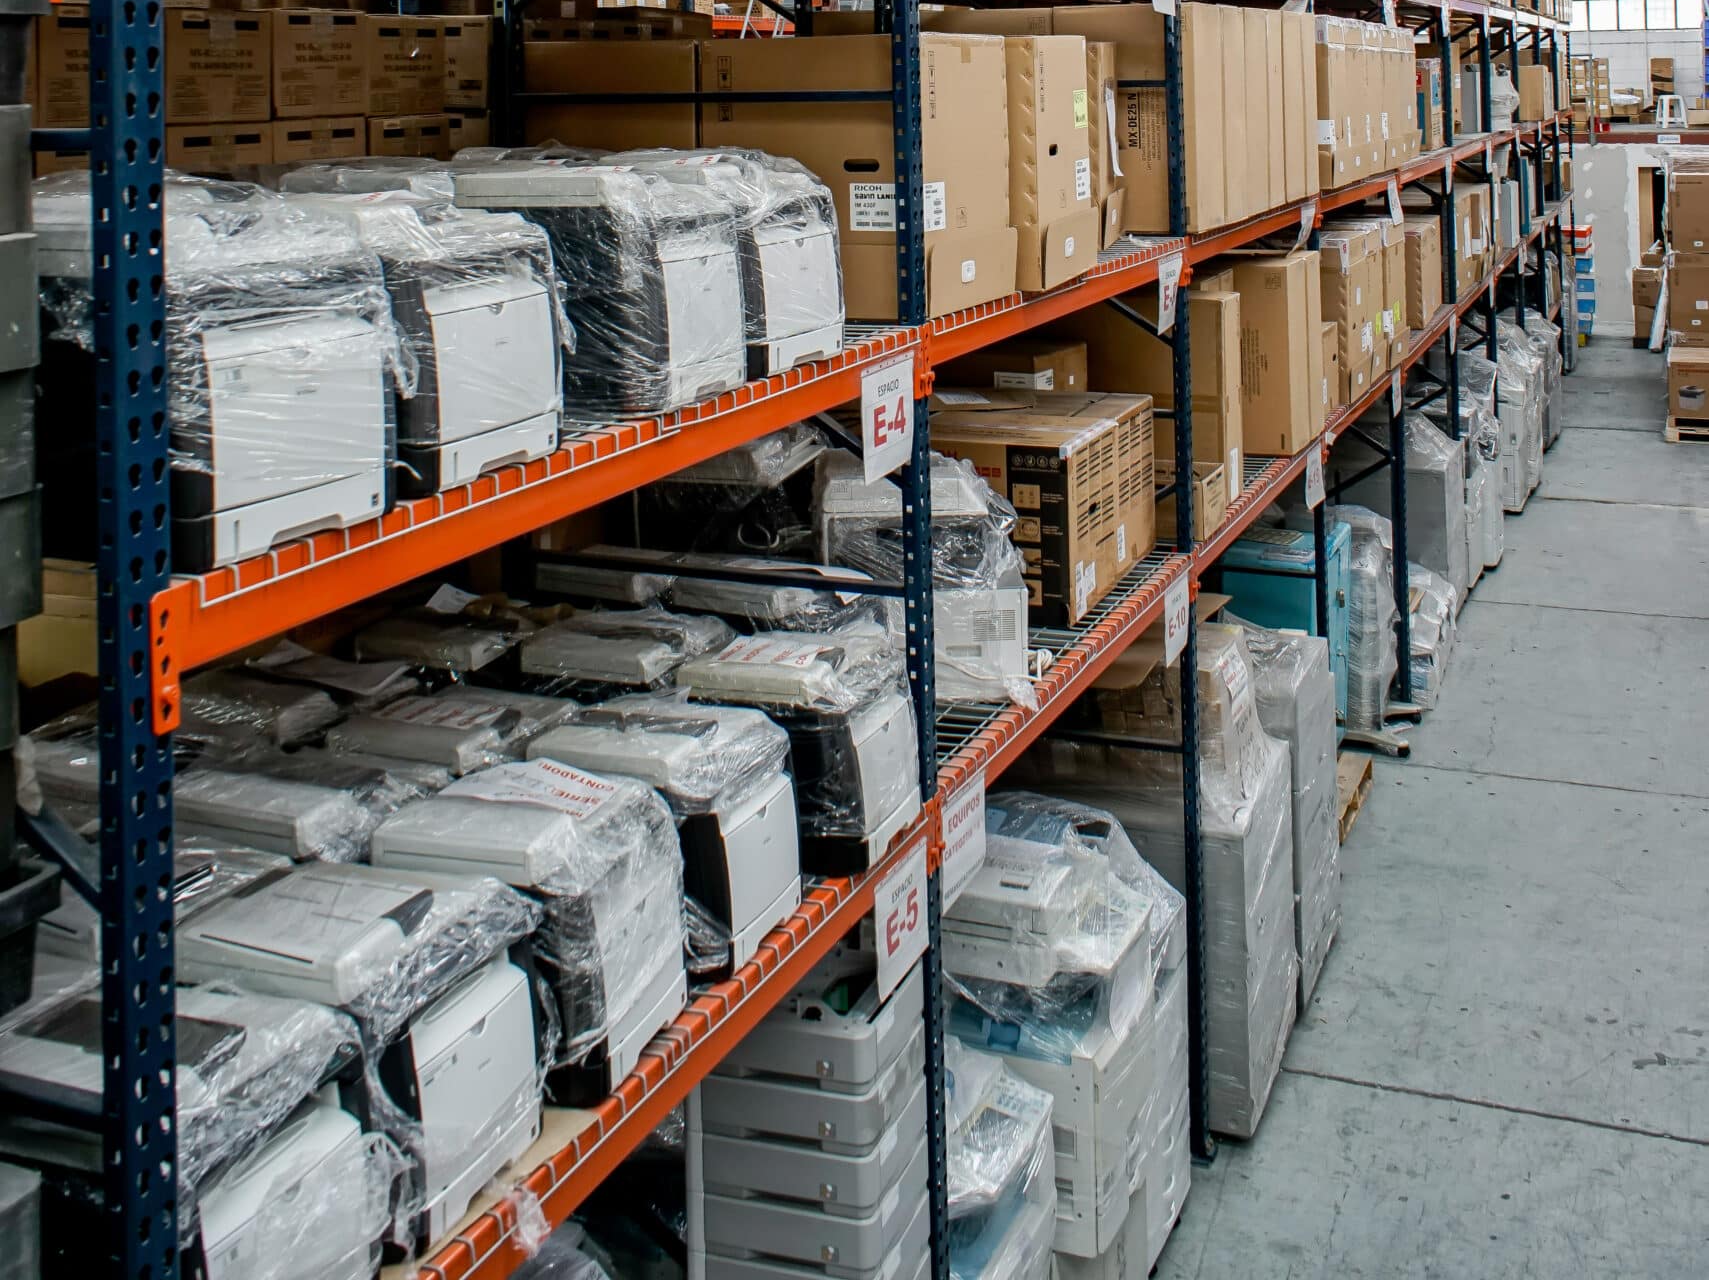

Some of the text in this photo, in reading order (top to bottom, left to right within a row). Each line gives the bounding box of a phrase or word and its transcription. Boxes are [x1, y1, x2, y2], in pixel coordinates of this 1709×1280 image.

[877, 379, 900, 397] ESPACIO
[873, 395, 907, 448] E-4
[538, 761, 615, 792] CONTADOR:
[947, 793, 981, 834] EQUIPOS
[891, 873, 914, 904] ESPACIO
[886, 887, 919, 958] E-5
